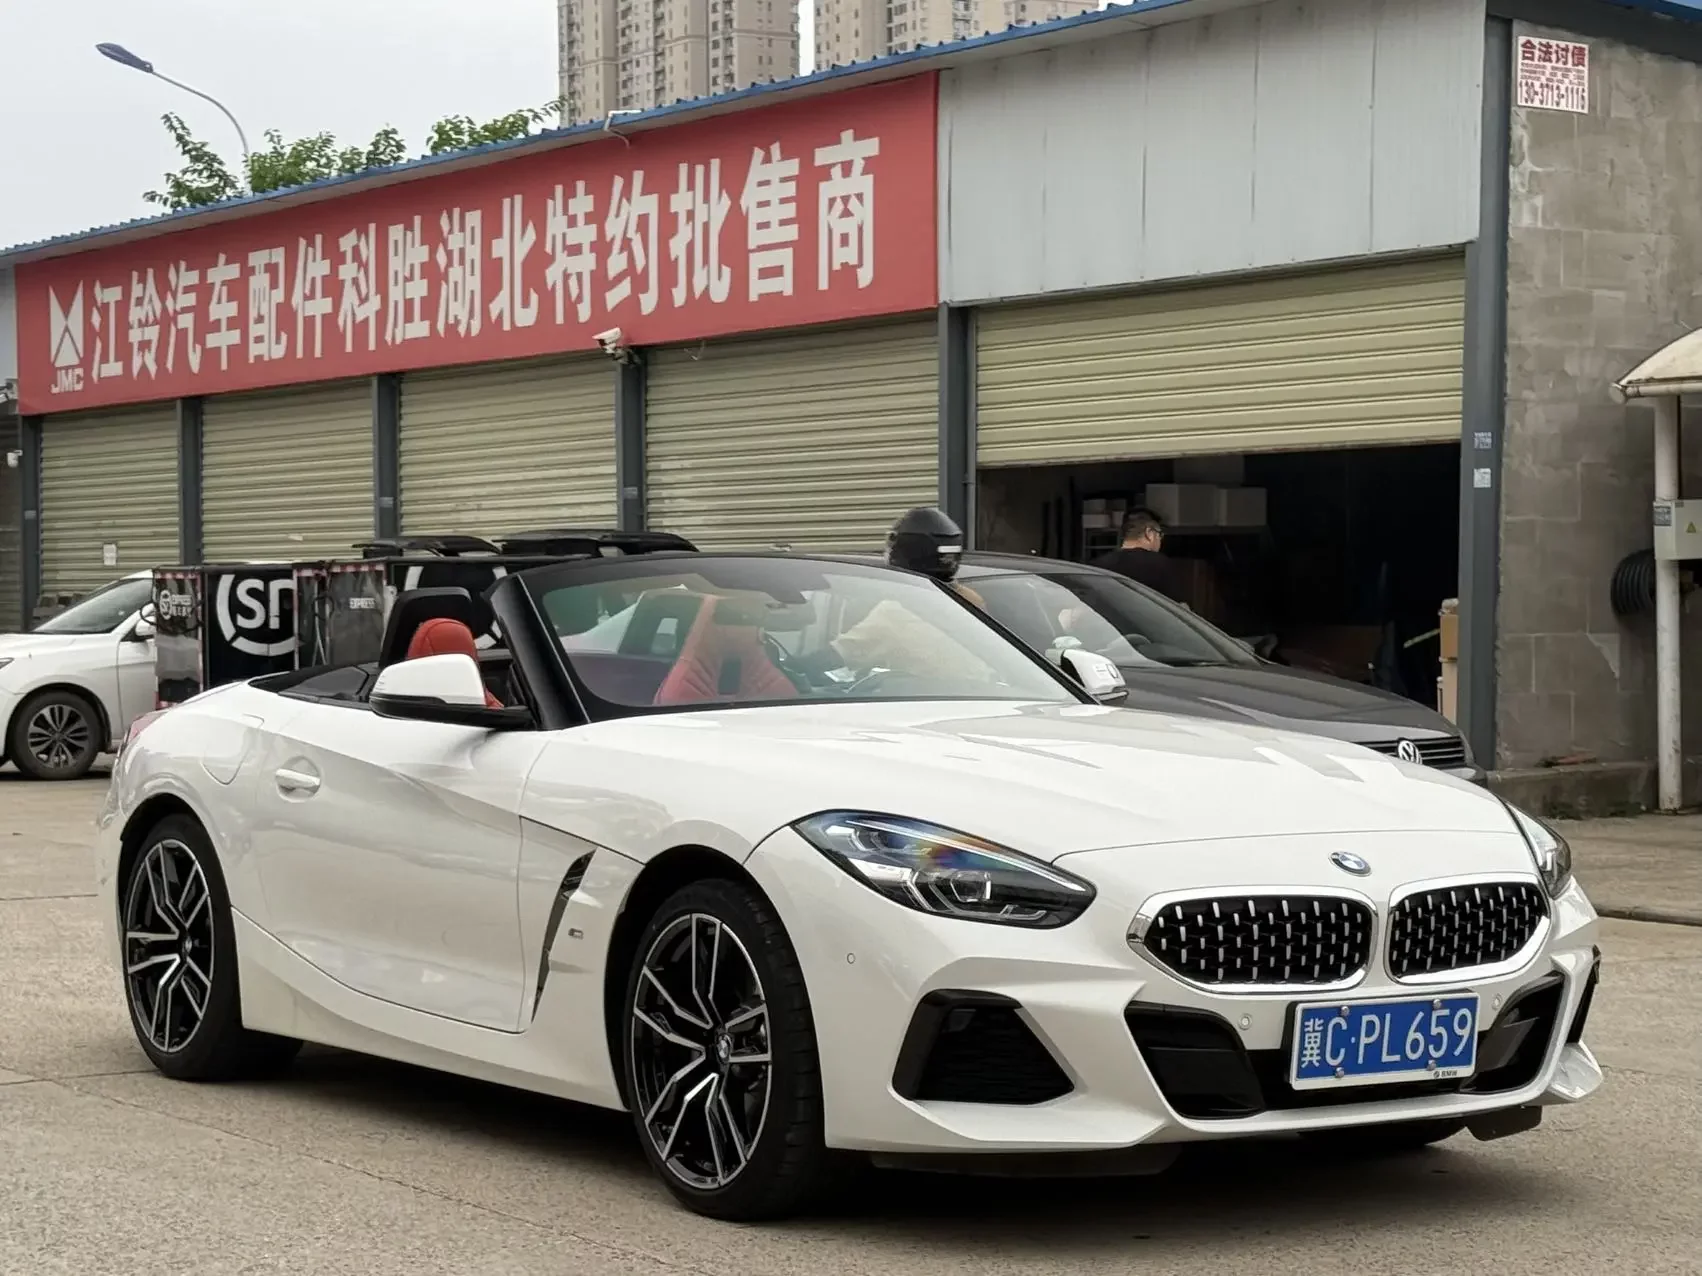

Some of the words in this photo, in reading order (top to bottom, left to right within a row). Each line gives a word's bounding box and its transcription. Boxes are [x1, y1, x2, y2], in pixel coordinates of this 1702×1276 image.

[91, 128, 881, 383] 江铃汽车配件科胜湖北特约批售商
[50, 367, 85, 394] JMC
